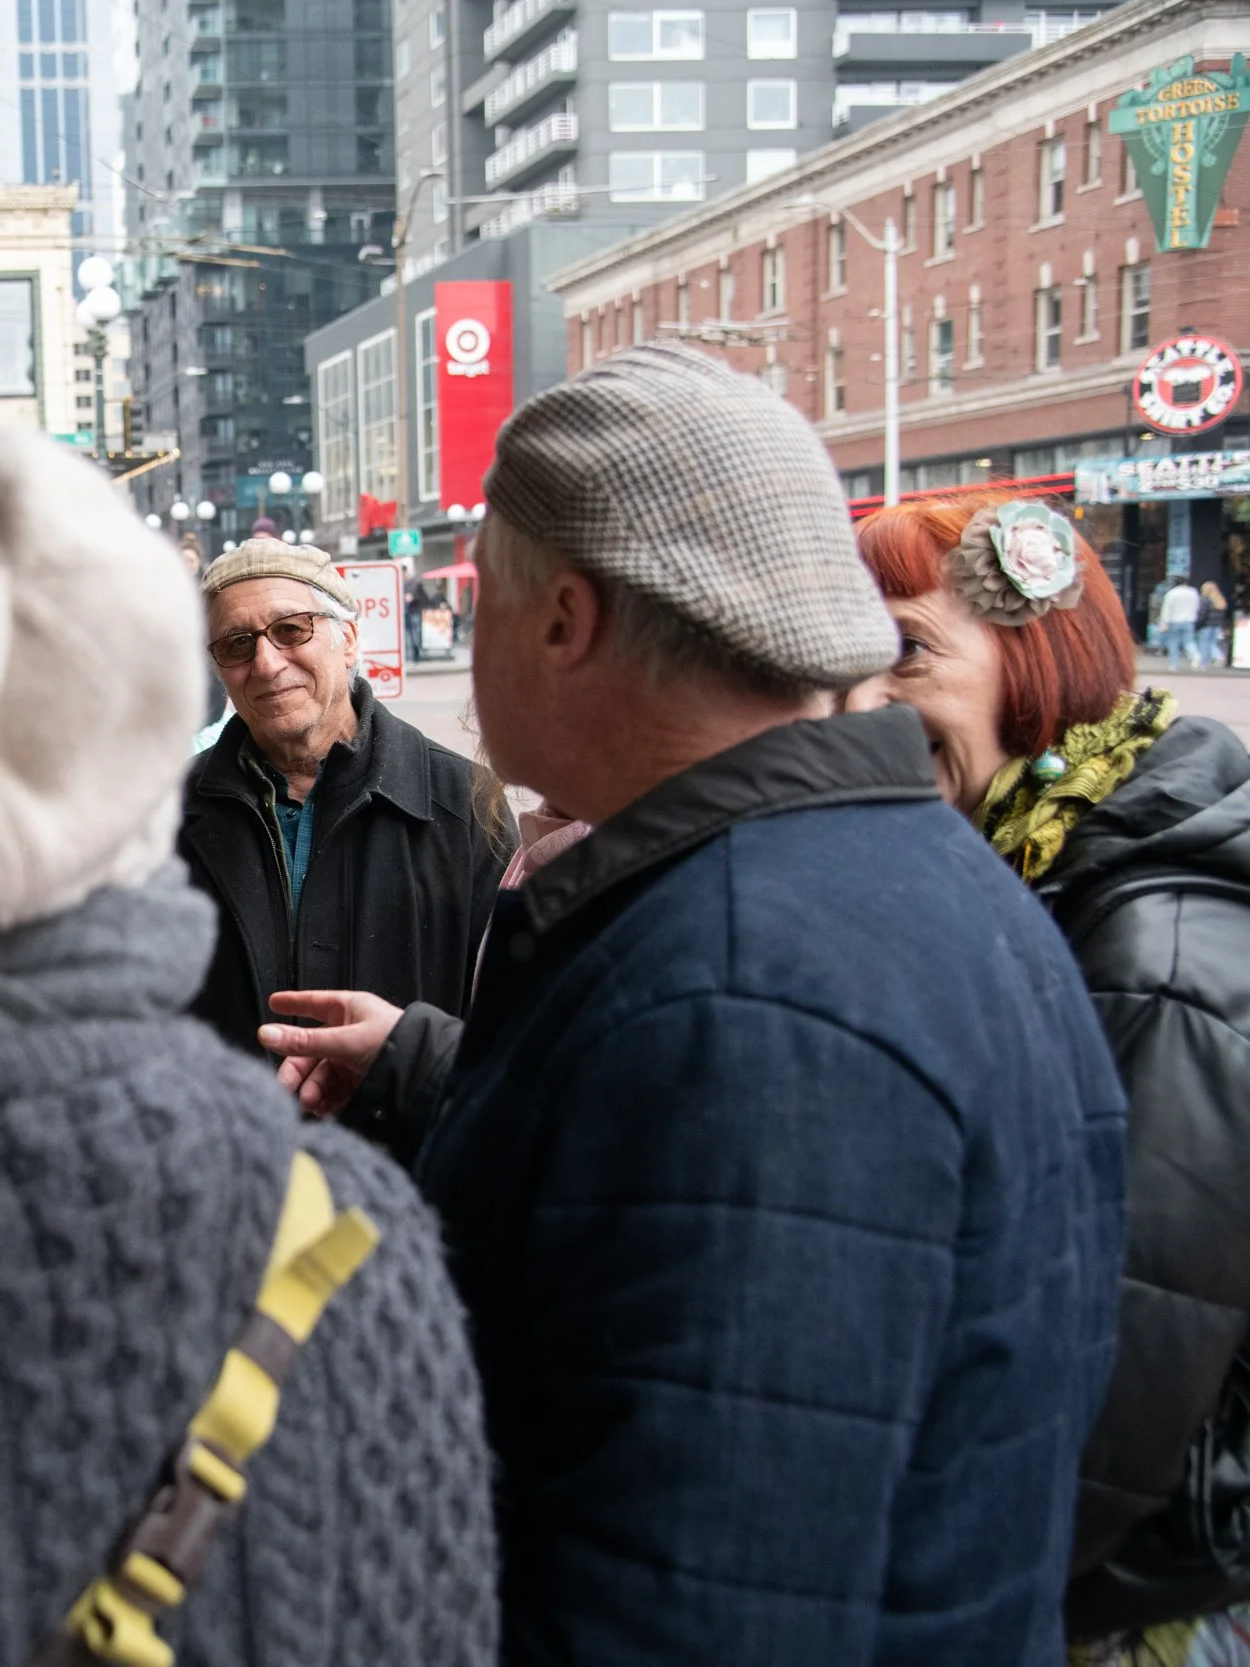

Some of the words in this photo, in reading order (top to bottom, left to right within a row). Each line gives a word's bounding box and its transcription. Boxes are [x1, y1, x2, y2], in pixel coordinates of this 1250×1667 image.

[1135, 93, 1240, 125] TORTOISE
[1158, 78, 1216, 101] GREEN
[1170, 121, 1195, 248] HOSTEL
[1139, 338, 1234, 384] SEATTLE
